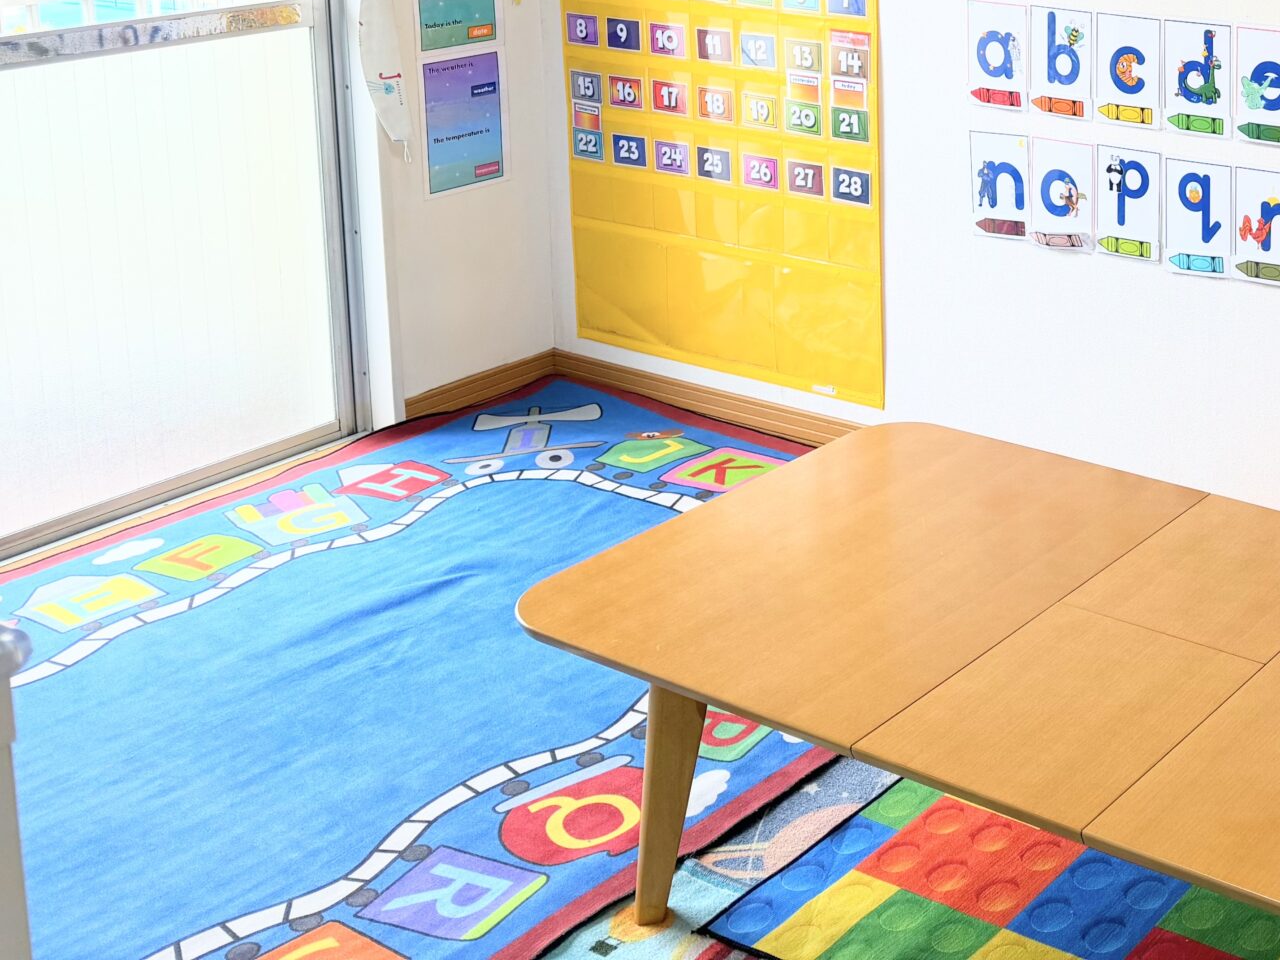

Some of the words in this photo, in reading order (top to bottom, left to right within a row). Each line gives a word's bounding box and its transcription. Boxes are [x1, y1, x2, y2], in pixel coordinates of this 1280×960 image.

[424, 22, 444, 30] Today
[472, 28, 488, 36] date
[575, 18, 587, 40] 8
[616, 23, 628, 43] 9
[655, 29, 679, 51] 10
[705, 33, 722, 56] 11
[747, 39, 768, 61] 12
[792, 46, 814, 68] 13
[838, 51, 863, 74] 14
[977, 30, 1014, 80] a
[1047, 11, 1082, 86] b
[1110, 45, 1146, 95] c
[1178, 29, 1215, 106] d
[441, 64, 467, 73] weather
[473, 86, 495, 94] weather
[577, 76, 595, 98] 15
[616, 81, 637, 104] 16
[660, 86, 680, 109] 17
[704, 93, 726, 115] 18
[749, 100, 770, 123] 19
[790, 105, 817, 128] 20
[838, 112, 861, 135] 21
[433, 137, 445, 145] The
[445, 130, 484, 142] temperature
[577, 133, 598, 154] 22
[618, 140, 640, 161] 23
[661, 146, 684, 168] 24
[703, 152, 723, 175] 25
[750, 160, 773, 183] 26
[793, 166, 815, 189] 27
[838, 174, 864, 198] 28
[987, 160, 1025, 211] n
[1040, 169, 1080, 218] o
[1117, 158, 1150, 227] p
[1178, 171, 1222, 244] q
[618, 439, 685, 463] J
[357, 467, 441, 497] H
[687, 457, 766, 486] K
[276, 502, 350, 535] G
[160, 541, 222, 572] F
[527, 793, 642, 850] Q
[380, 862, 513, 919] R
